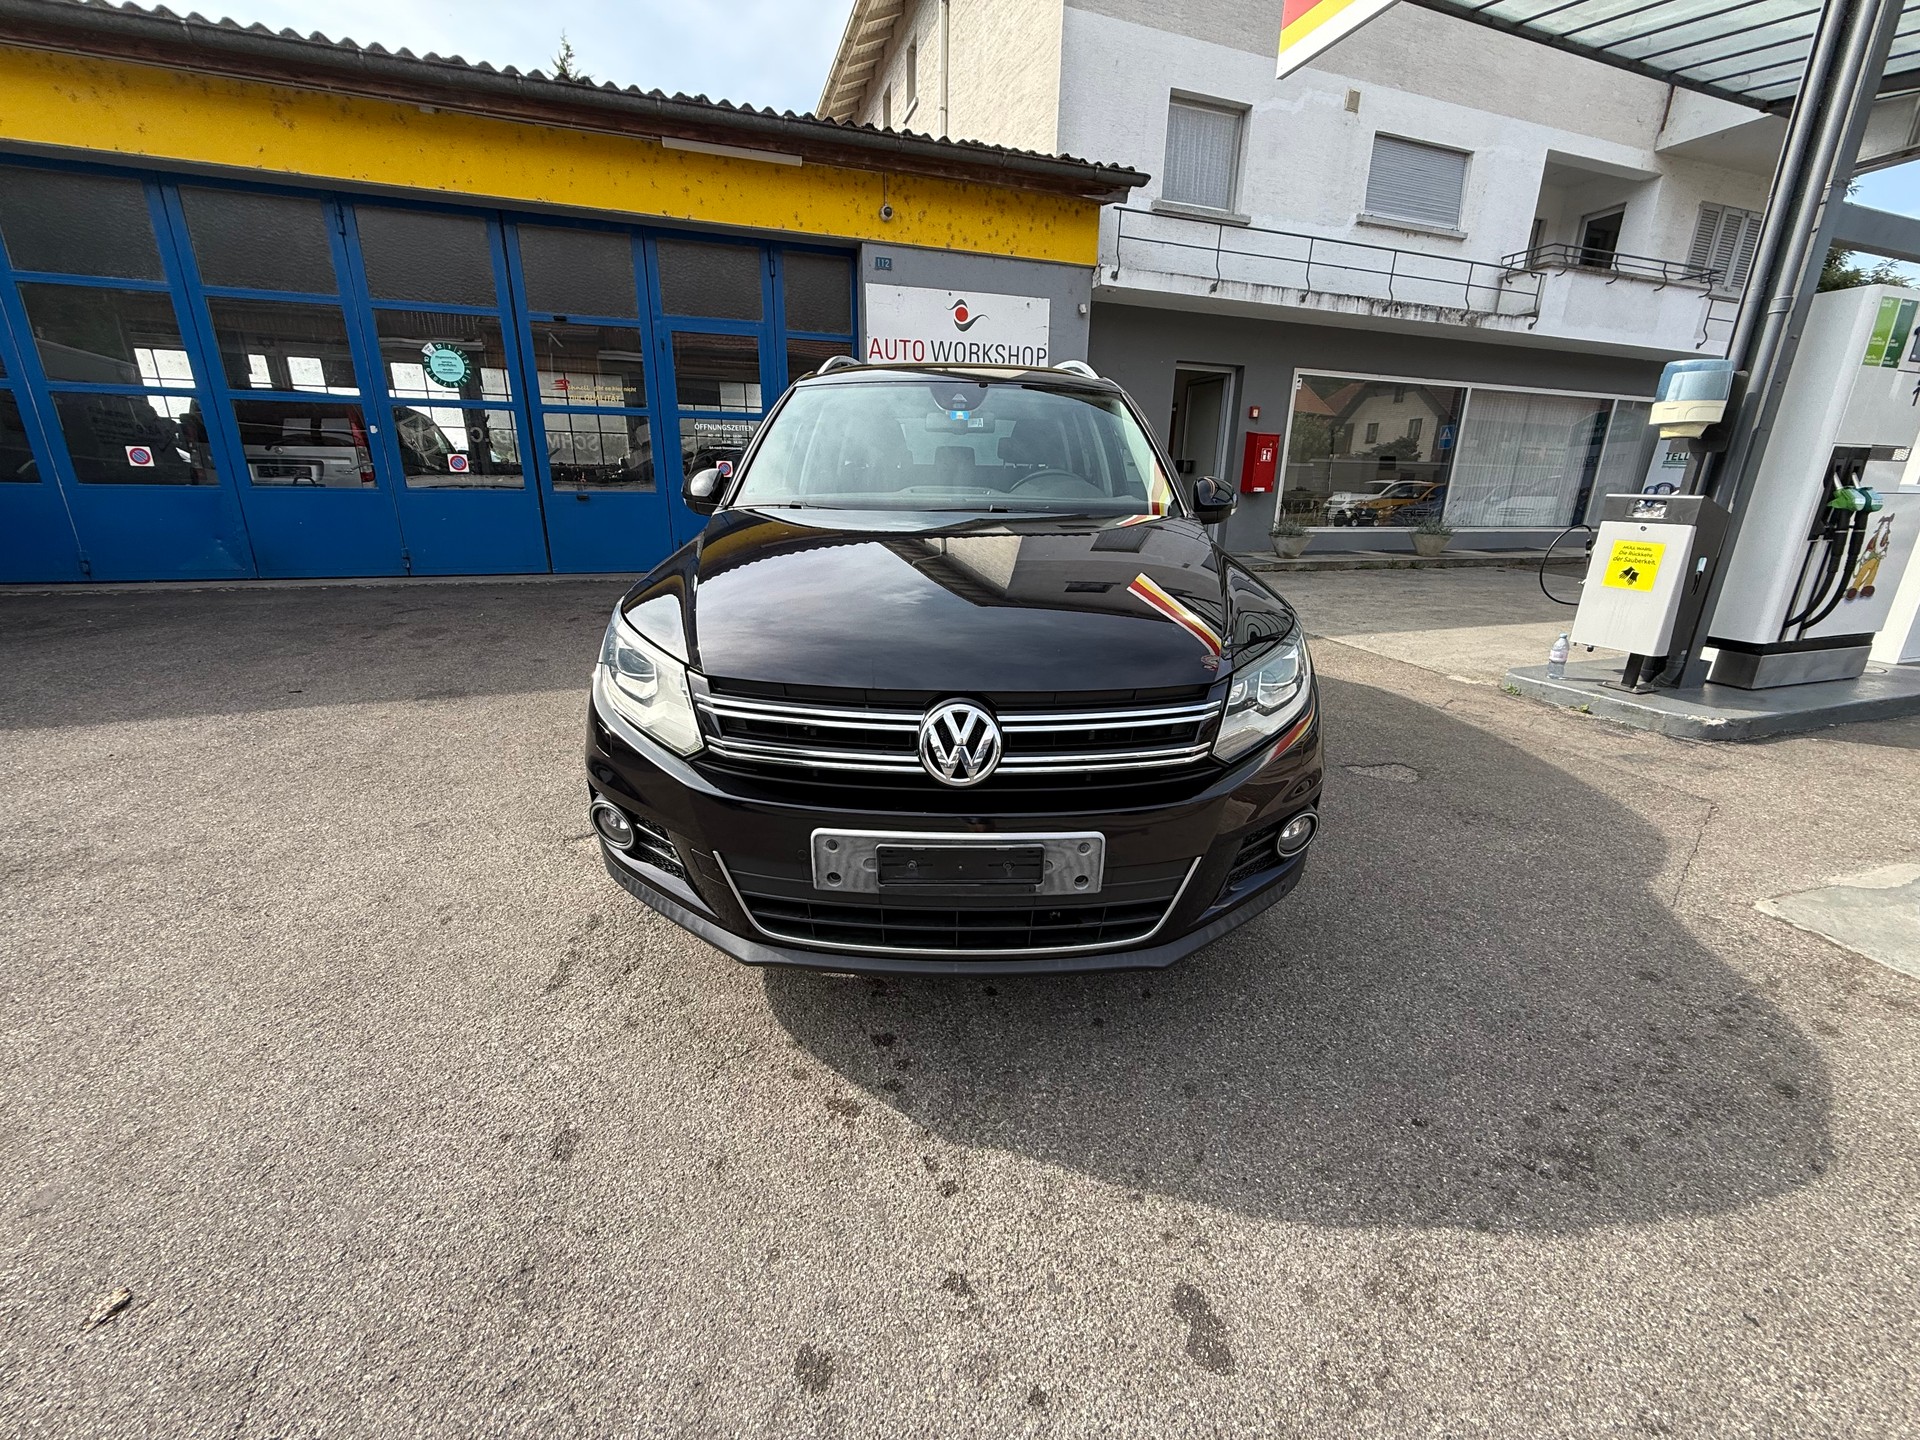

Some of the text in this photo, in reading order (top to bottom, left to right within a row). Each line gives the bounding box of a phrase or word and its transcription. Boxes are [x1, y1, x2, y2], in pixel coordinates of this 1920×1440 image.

[877, 258, 890, 268] 112
[869, 338, 1047, 366] AUTO WORKSHOP
[694, 422, 754, 431] ÖFFNUNGSZEITEN
